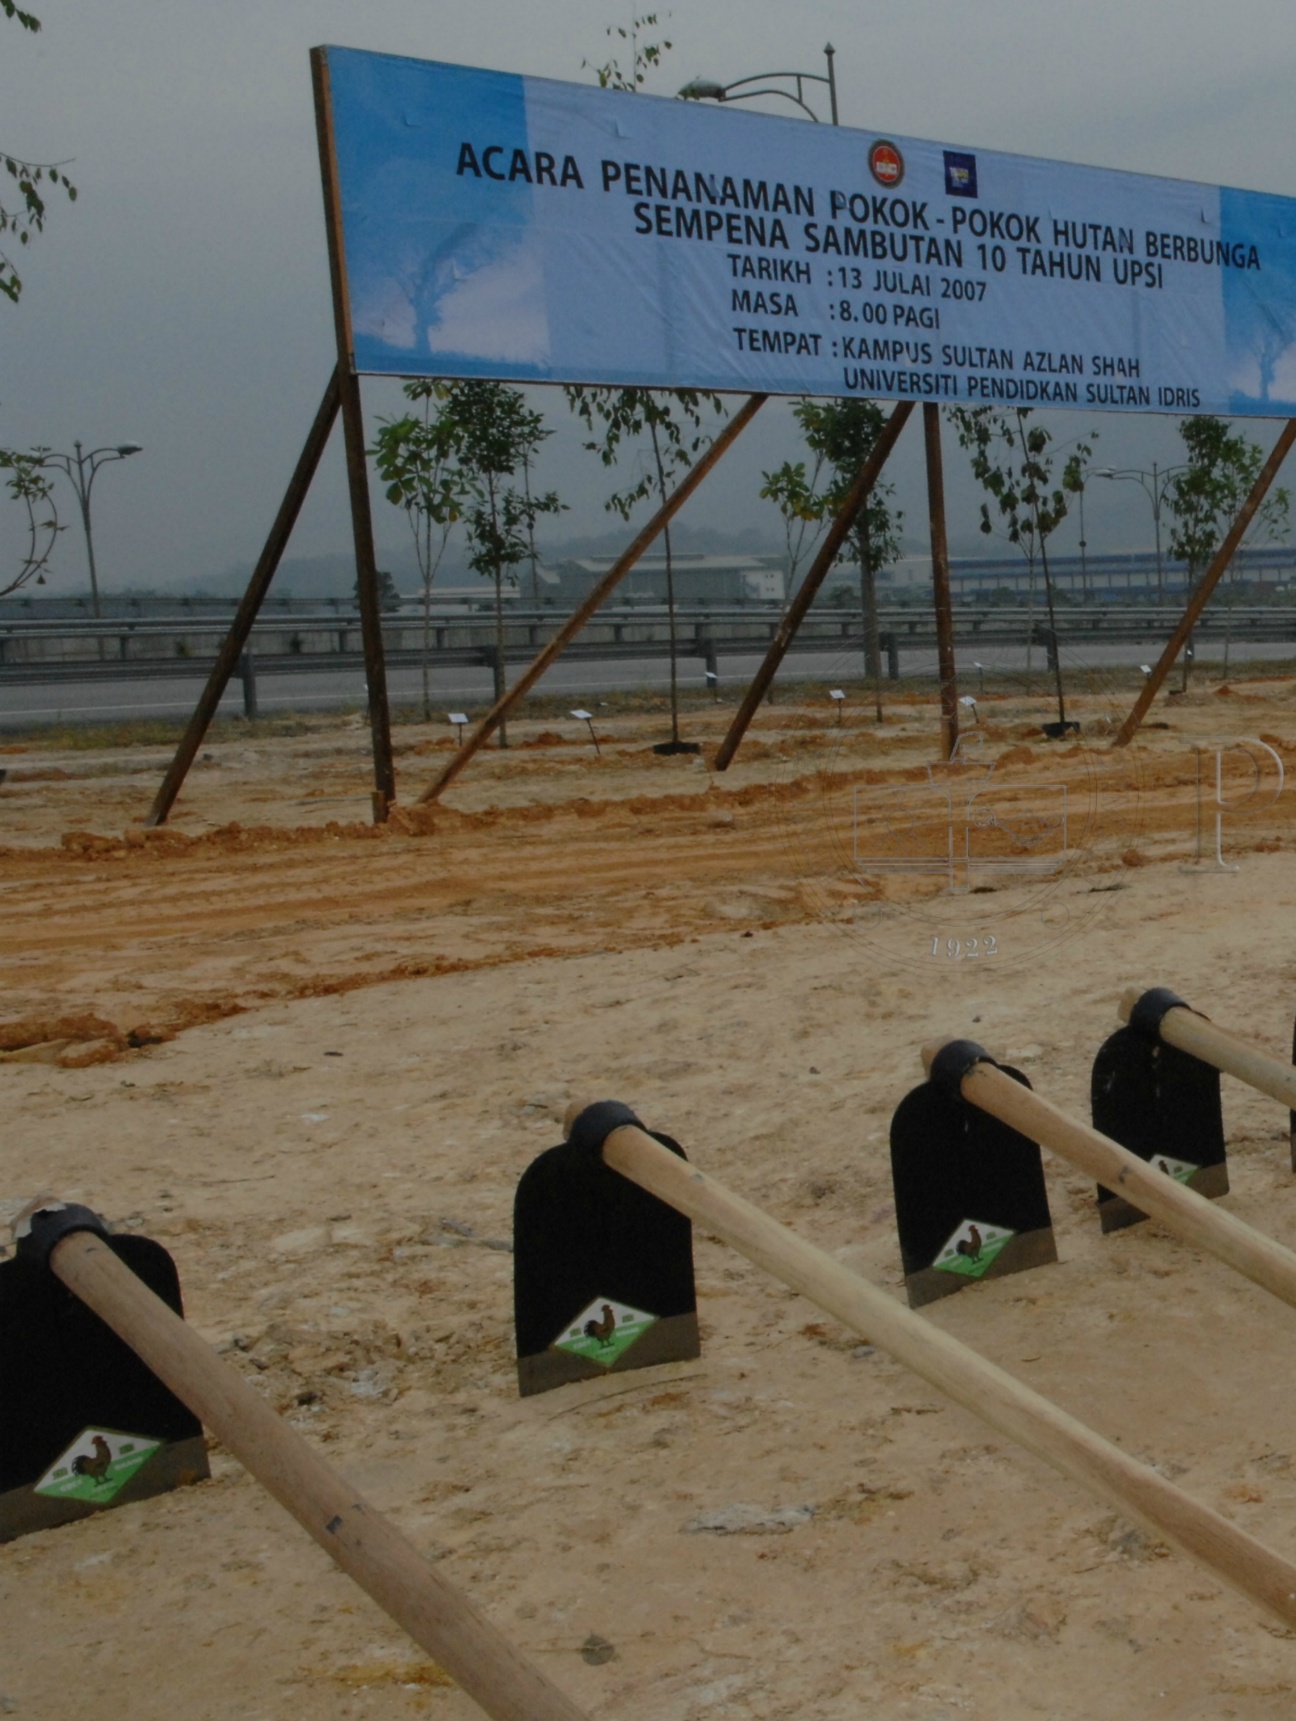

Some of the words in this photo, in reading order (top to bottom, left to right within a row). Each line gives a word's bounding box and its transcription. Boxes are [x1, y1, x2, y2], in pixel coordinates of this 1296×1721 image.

[456, 142, 584, 189] ACARA
[601, 160, 815, 217] PENANAMAN
[1053, 219, 1134, 254] HUTAN
[1146, 231, 1260, 270] BERBUNGA
[634, 202, 789, 249] SEMPENA
[804, 222, 963, 268] SAMBUTAN
[977, 244, 1006, 272] 10
[1017, 247, 1101, 282] TAHUN
[1114, 258, 1163, 288] UPSI
[727, 253, 811, 284] TARIKH
[873, 269, 931, 296] JULAI
[941, 278, 986, 302] 2007
[731, 289, 798, 317] MASA
[892, 304, 940, 329] PAGI
[733, 327, 821, 356] TEMPAT
[942, 345, 1013, 370] SULTAN
[1023, 351, 1083, 375] AZLAN
[1092, 355, 1140, 378] SHAH
[844, 367, 957, 396] UNIVERSITI
[968, 376, 1077, 402] PENDIDKAN
[1086, 383, 1150, 406] SULTAN
[1158, 387, 1201, 408] IDRIS
